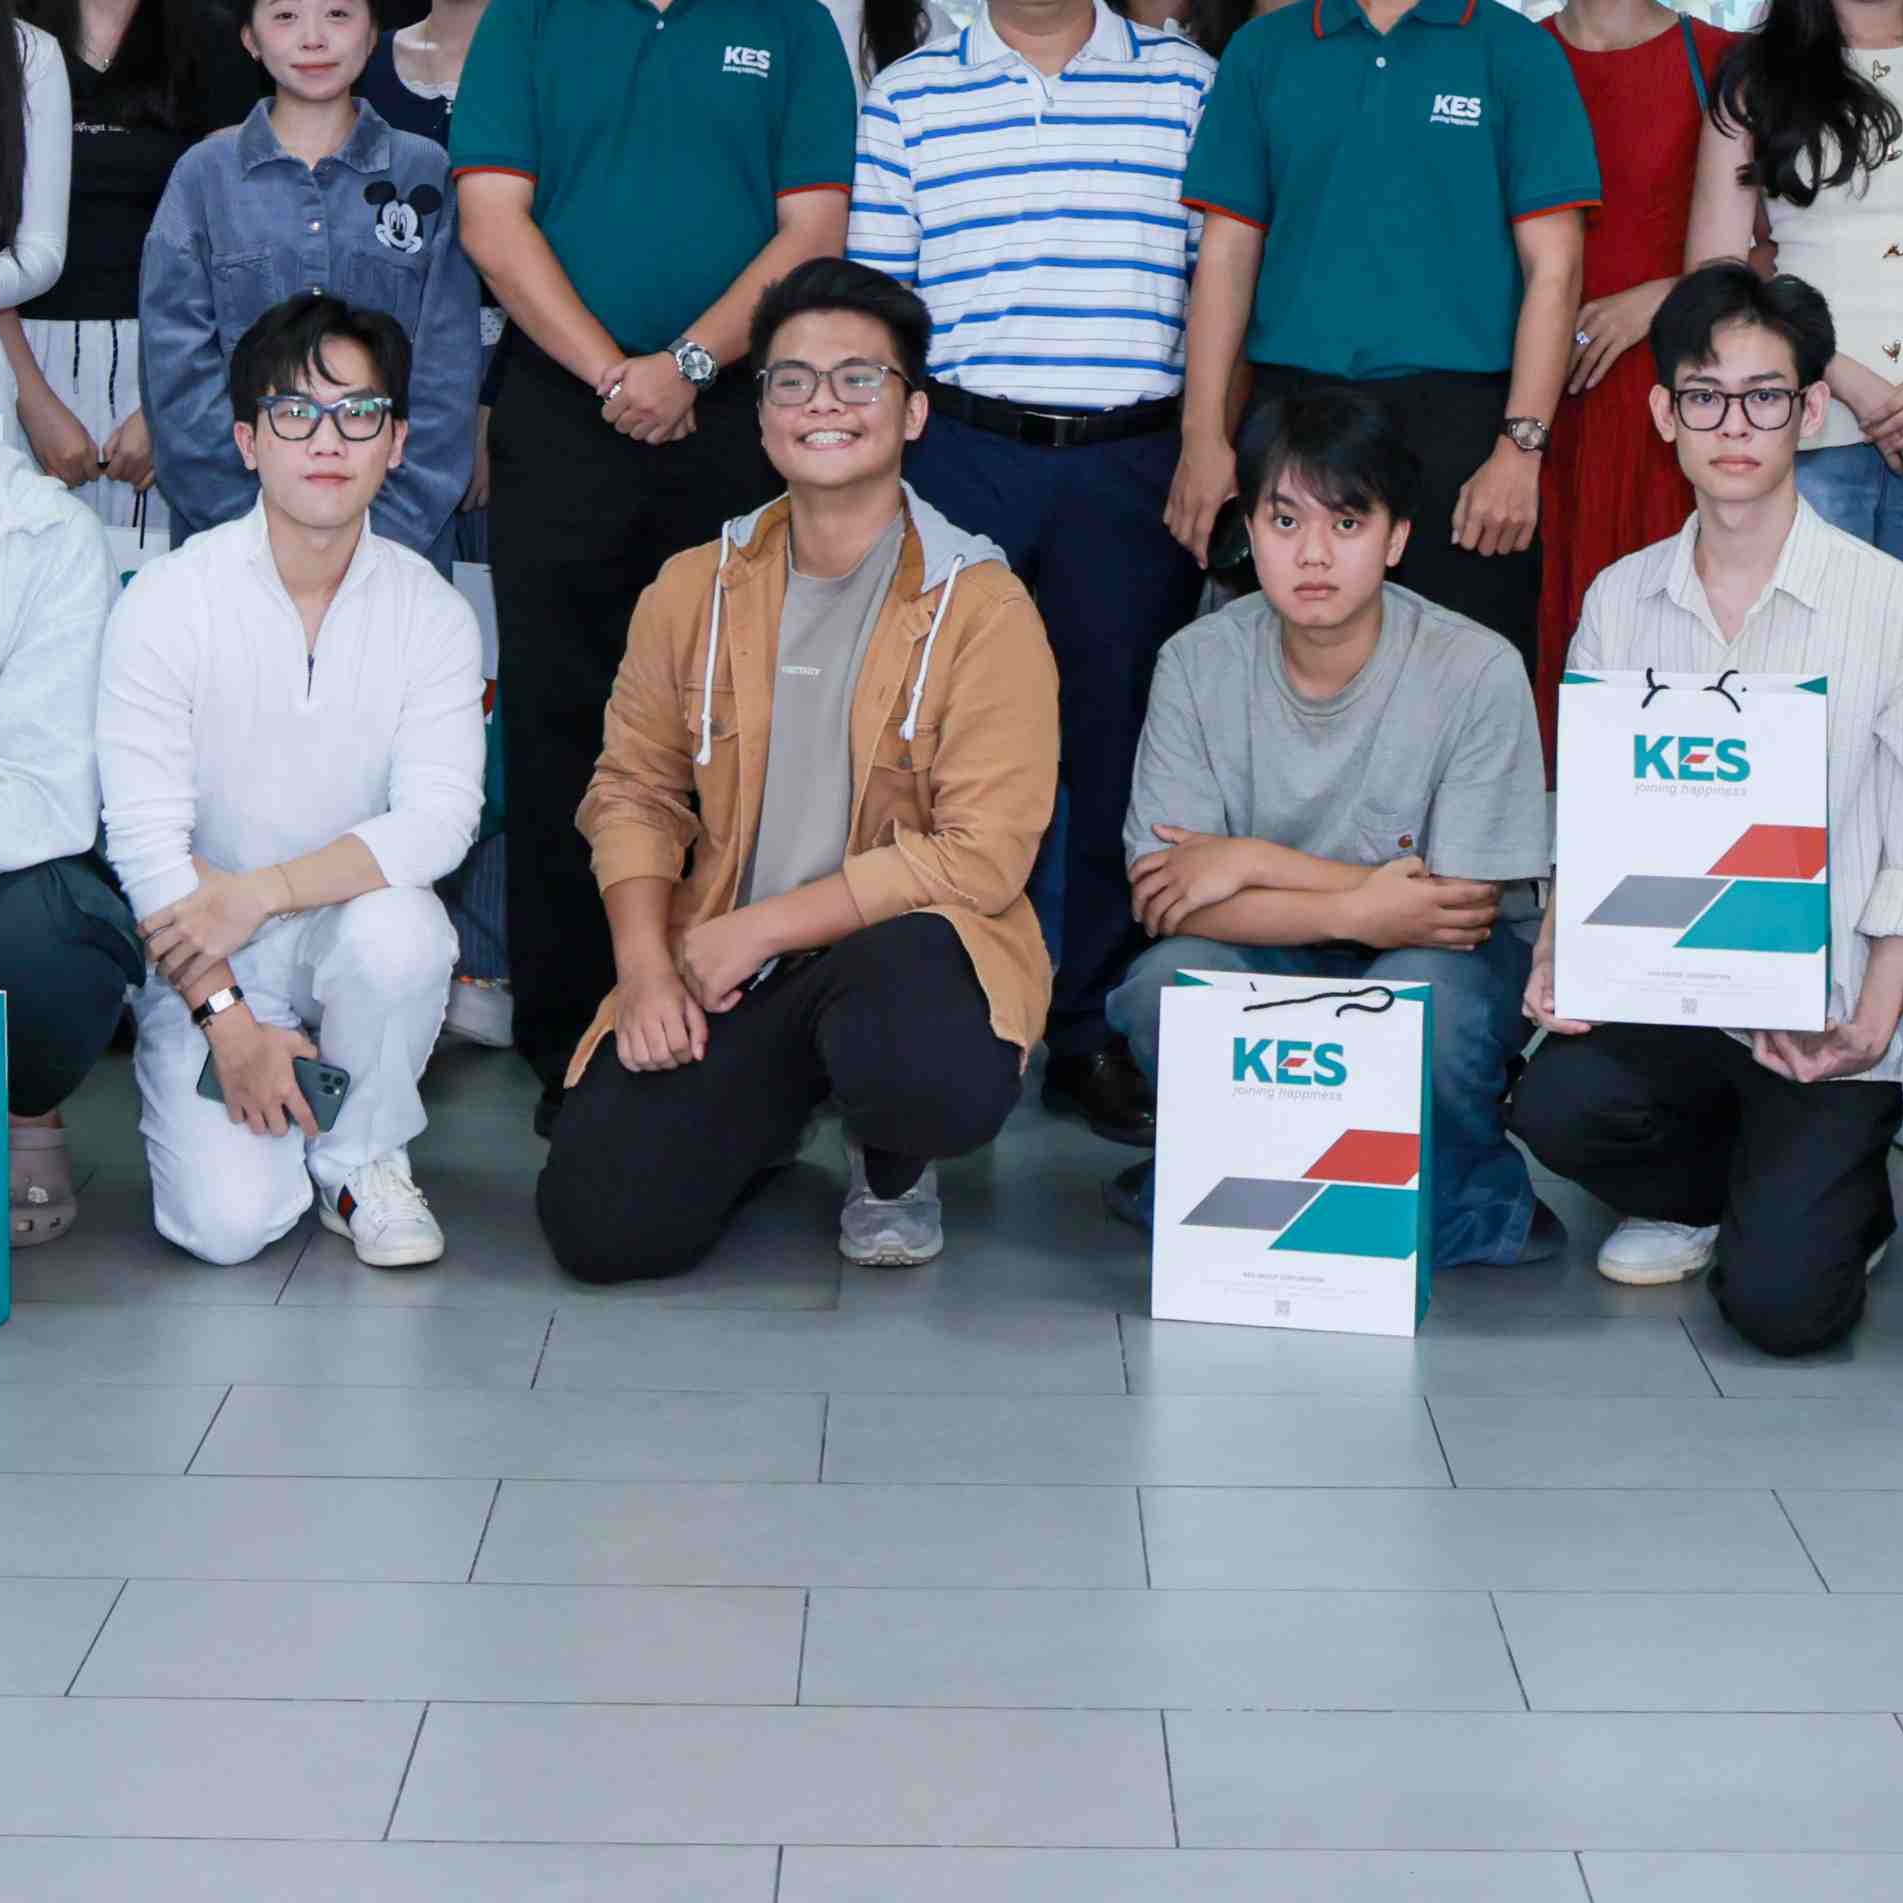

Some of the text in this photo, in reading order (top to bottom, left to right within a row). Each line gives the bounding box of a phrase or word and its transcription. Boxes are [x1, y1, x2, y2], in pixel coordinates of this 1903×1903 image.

[724, 46, 770, 70] KES
[1433, 95, 1481, 118] KES
[1633, 734, 1751, 783] KES
[1634, 782, 1747, 798] joining happiness
[1232, 1037, 1348, 1086] KES
[1232, 1086, 1343, 1102] joining happiness
